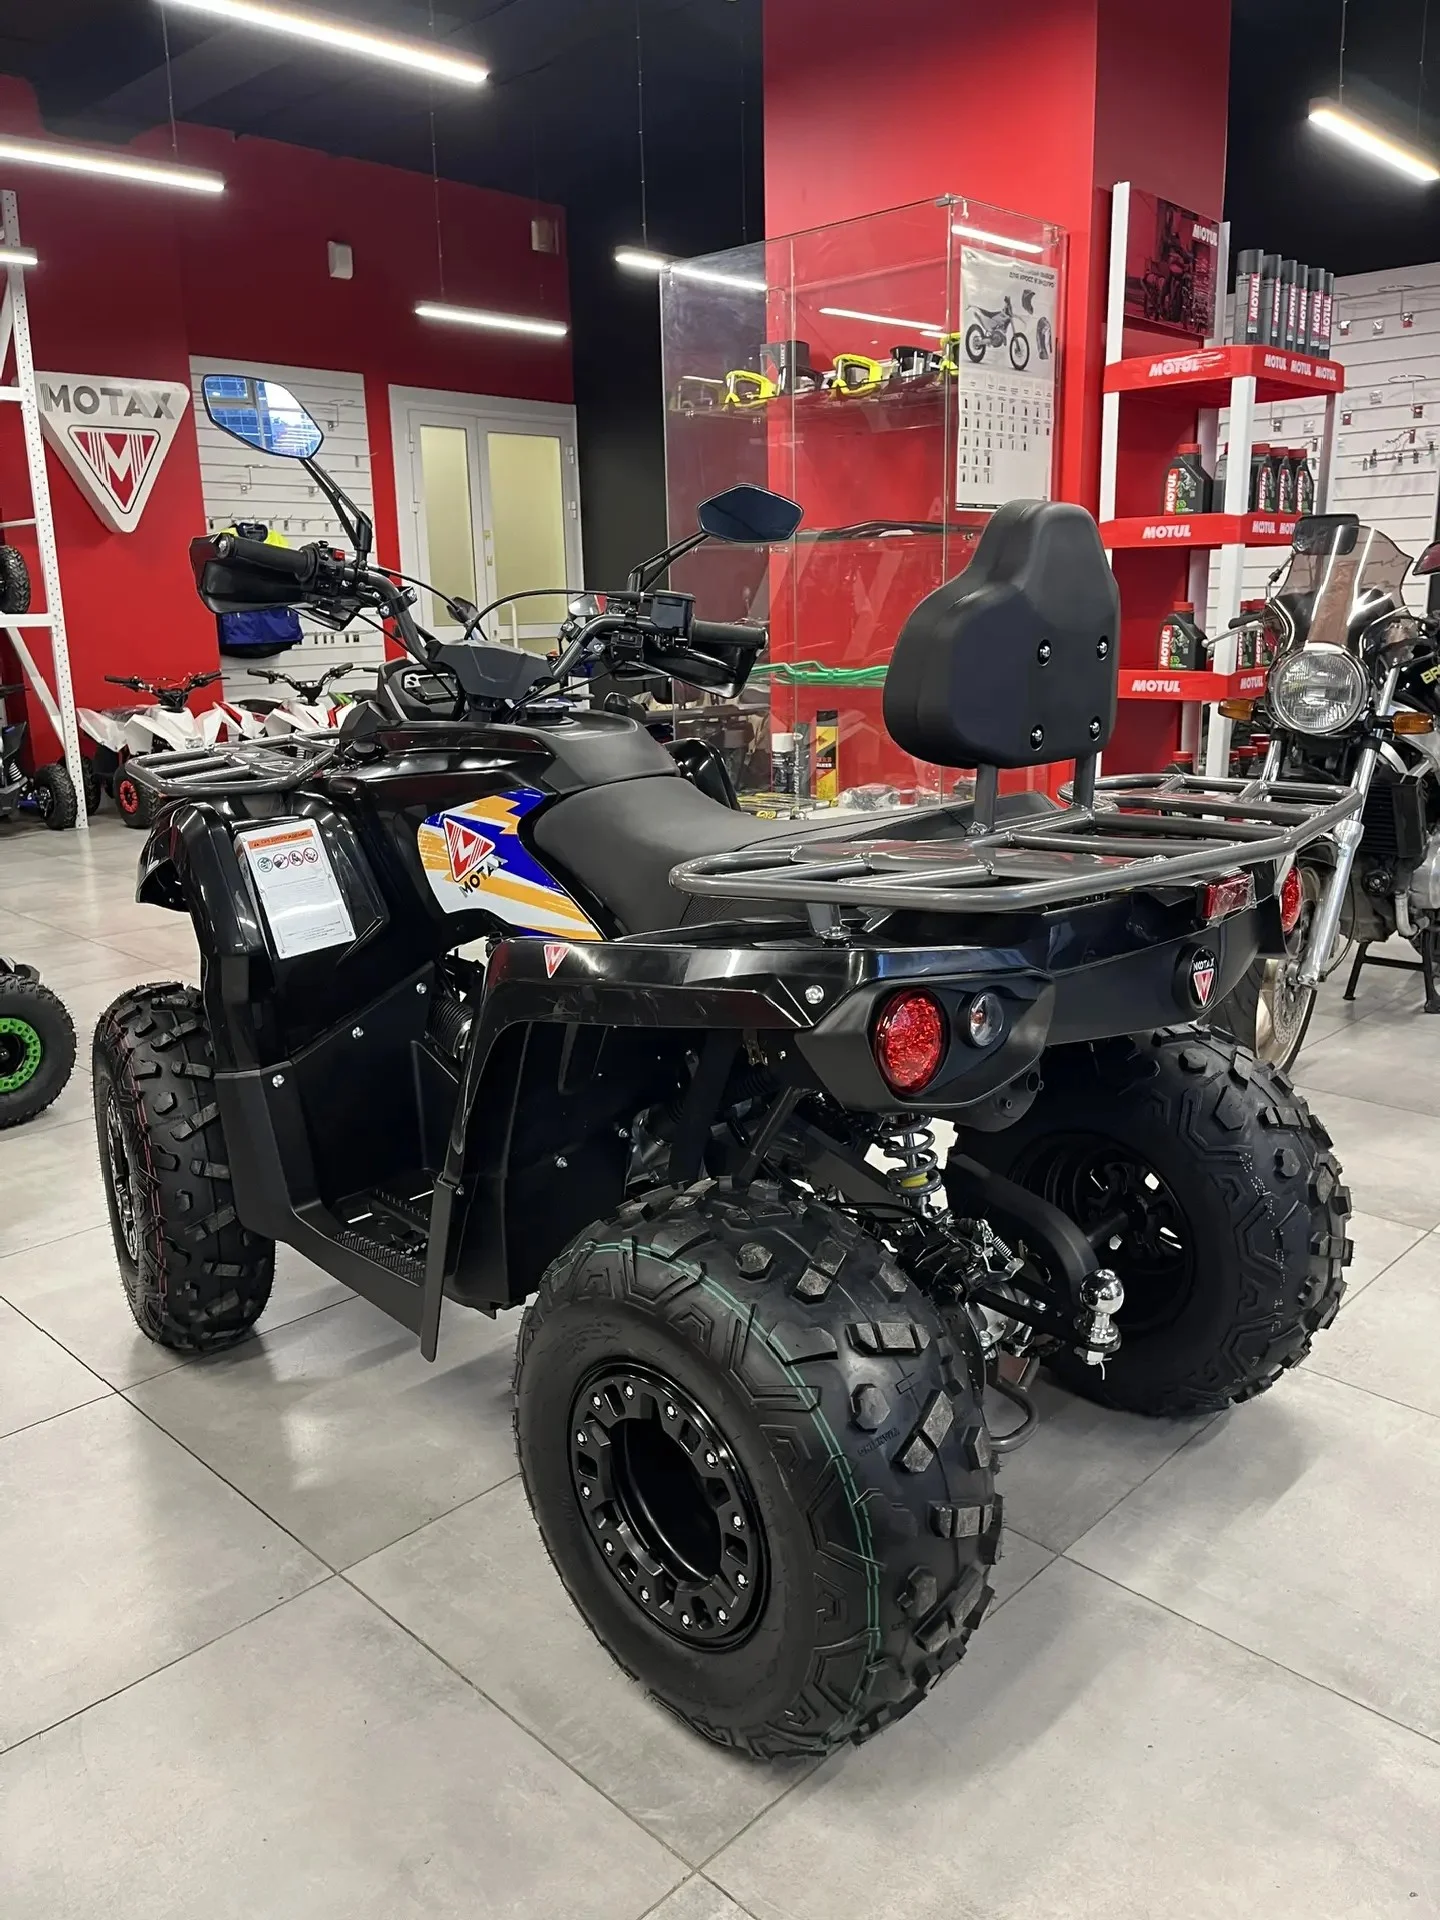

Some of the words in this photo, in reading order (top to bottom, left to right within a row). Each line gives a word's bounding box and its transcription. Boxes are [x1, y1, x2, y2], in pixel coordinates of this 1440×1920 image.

[1192, 224, 1218, 246] MOTUL
[1250, 275, 1260, 318] MOTUL
[1313, 290, 1322, 333] MOTUL
[1322, 294, 1332, 337] MOTUL
[1264, 354, 1287, 371] MOTUL
[39, 383, 176, 420] MOTAX
[1166, 475, 1177, 512] MOTUL
[1143, 525, 1191, 539] MOTUL
[1160, 630, 1170, 666] MOTUL
[1132, 680, 1181, 693] MOTUL
